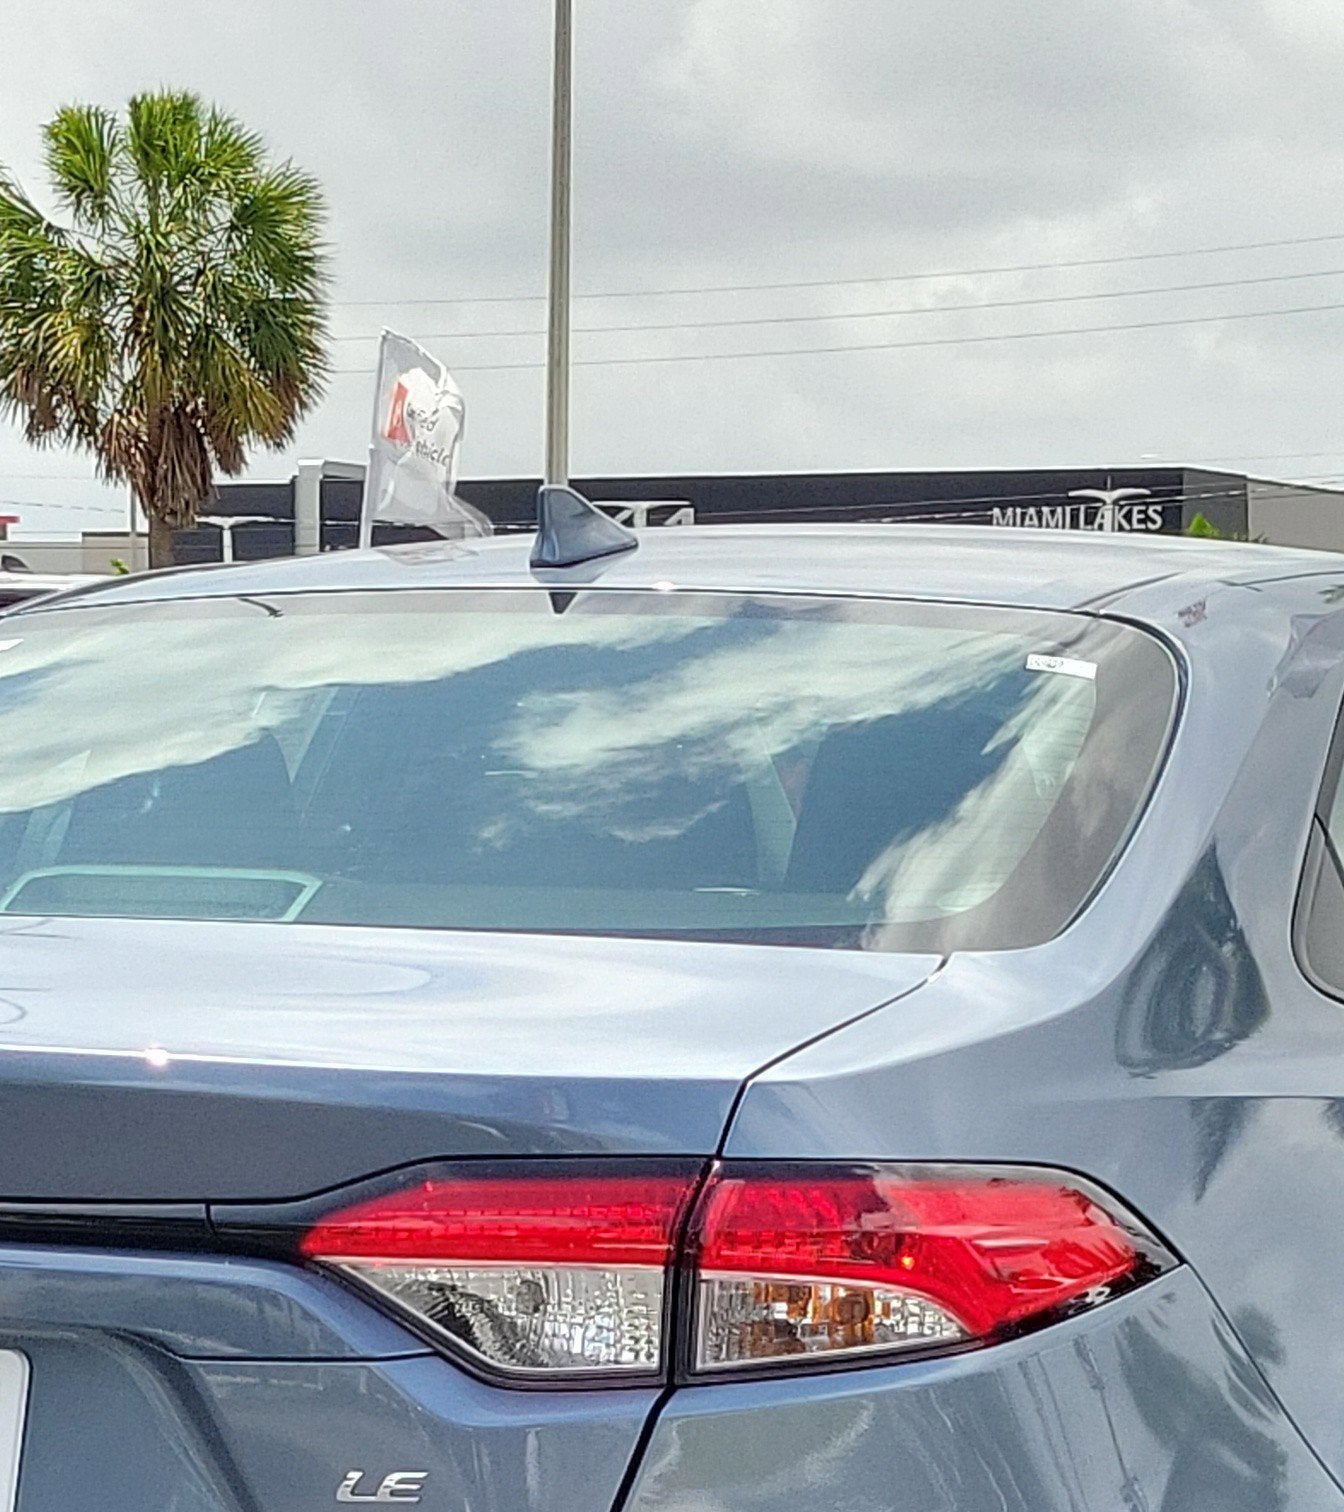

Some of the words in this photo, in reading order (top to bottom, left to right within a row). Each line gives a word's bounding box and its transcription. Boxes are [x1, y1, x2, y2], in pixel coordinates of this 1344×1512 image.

[992, 506, 1072, 530] MIAMI
[1079, 505, 1163, 532] LAKES
[336, 1471, 429, 1502] LE
